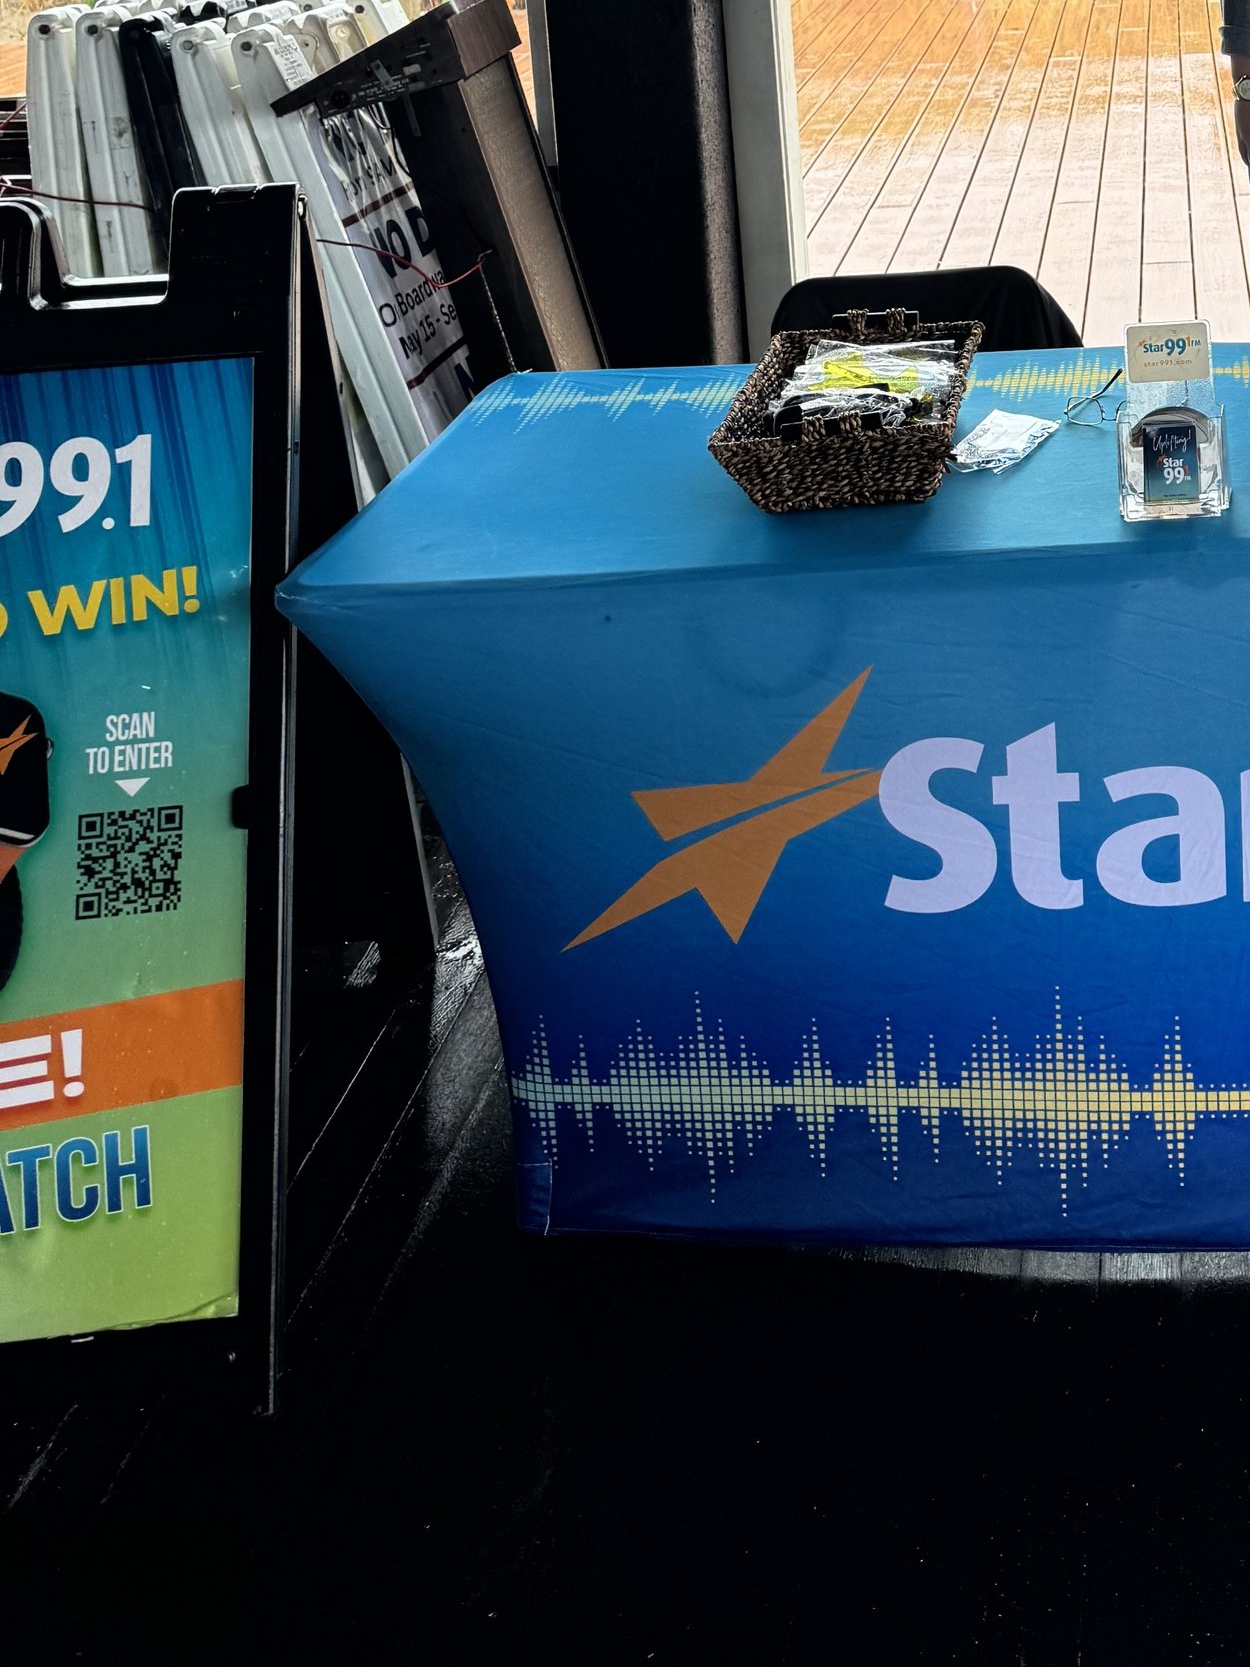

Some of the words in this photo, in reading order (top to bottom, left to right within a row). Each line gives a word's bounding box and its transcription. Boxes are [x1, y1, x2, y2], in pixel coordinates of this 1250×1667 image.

[1143, 342, 1164, 353] Star
[1144, 359, 1192, 367] star991.com
[1163, 457, 1184, 468] Star
[27, 565, 201, 637] WIN!
[105, 711, 155, 741] SCAN
[86, 746, 111, 775] TO
[113, 740, 173, 773] ENTER
